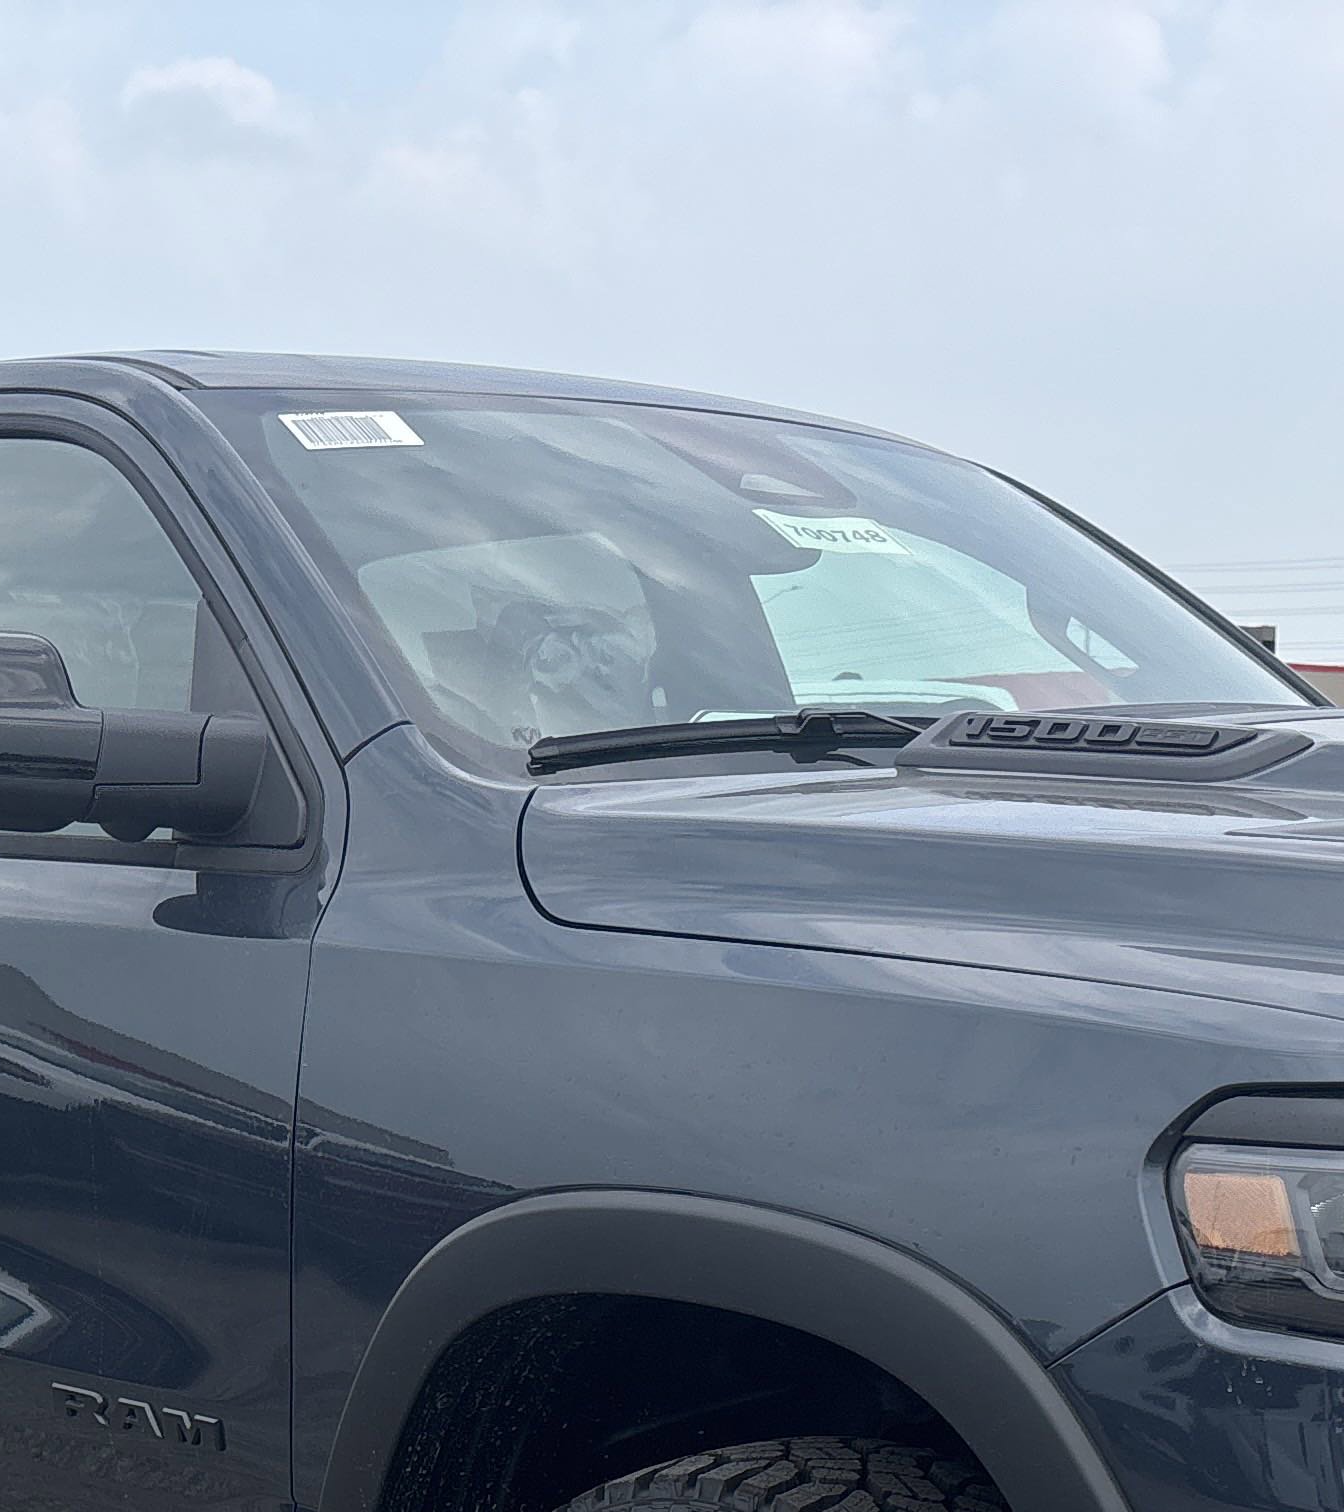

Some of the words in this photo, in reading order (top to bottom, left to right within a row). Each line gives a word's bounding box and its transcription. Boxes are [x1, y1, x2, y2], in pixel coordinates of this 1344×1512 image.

[783, 523, 887, 543] 700748
[967, 714, 1139, 746] 1500
[52, 1382, 226, 1451] RAM
